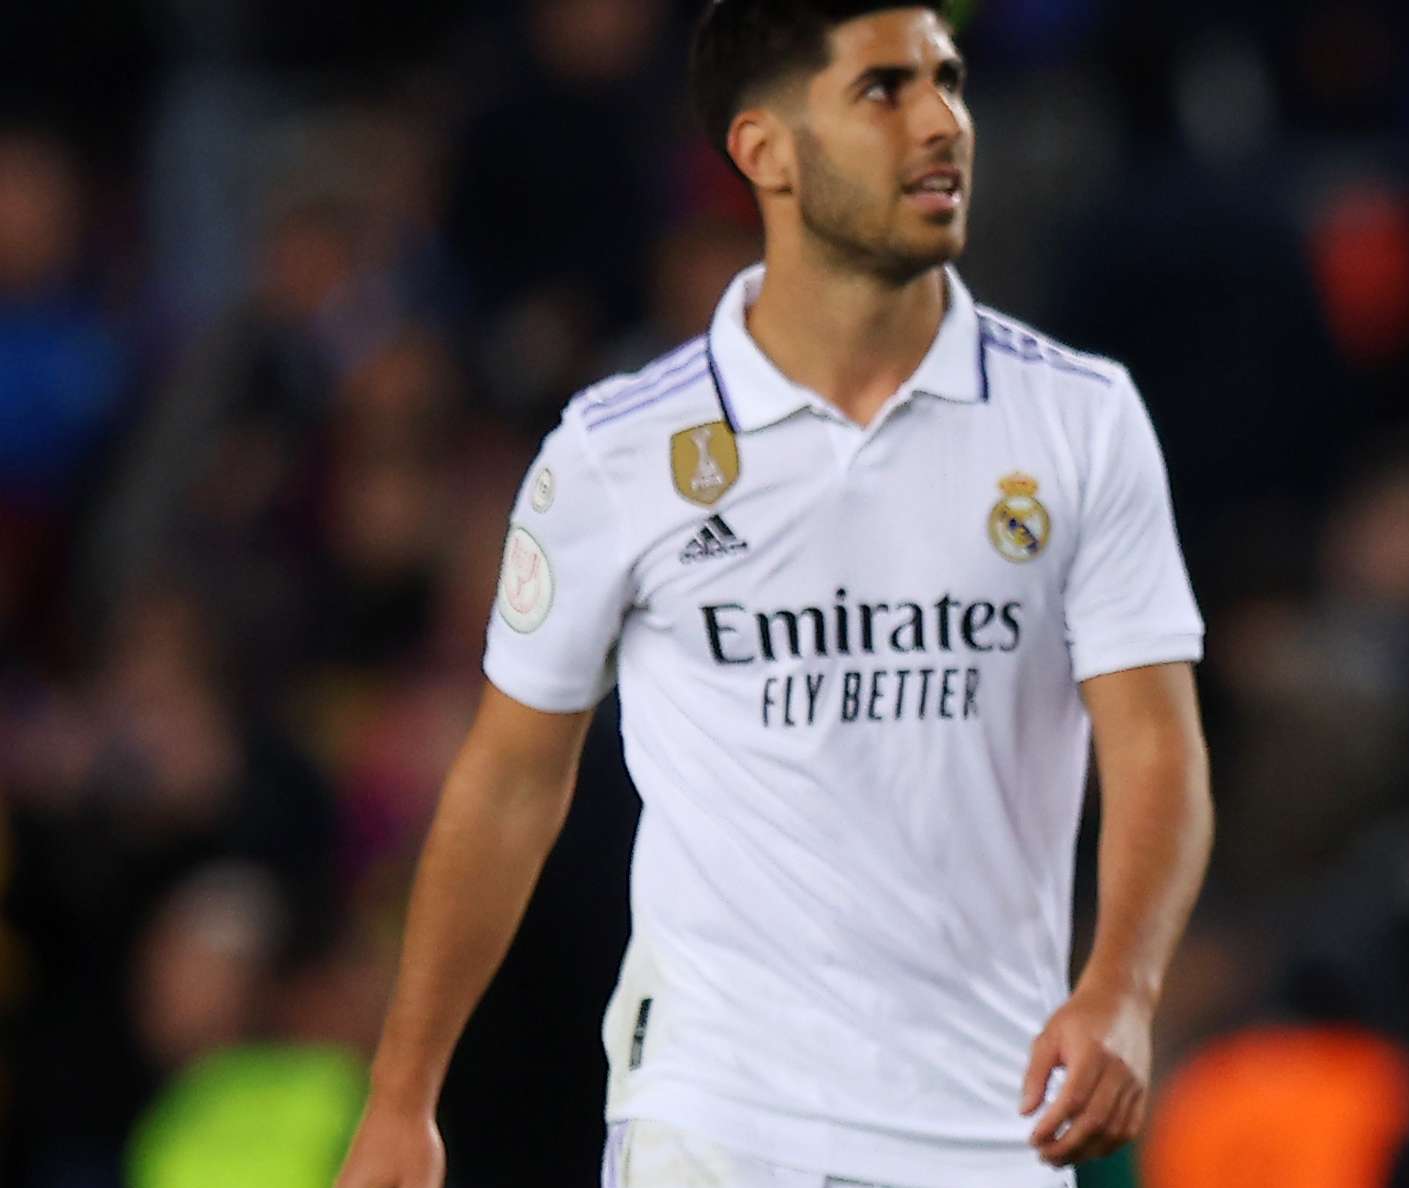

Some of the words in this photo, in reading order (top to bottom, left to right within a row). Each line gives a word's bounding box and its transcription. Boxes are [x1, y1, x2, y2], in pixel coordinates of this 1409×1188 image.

[701, 588, 1021, 665] Emirates
[761, 674, 824, 726] FLY
[840, 668, 979, 722] BETTER
